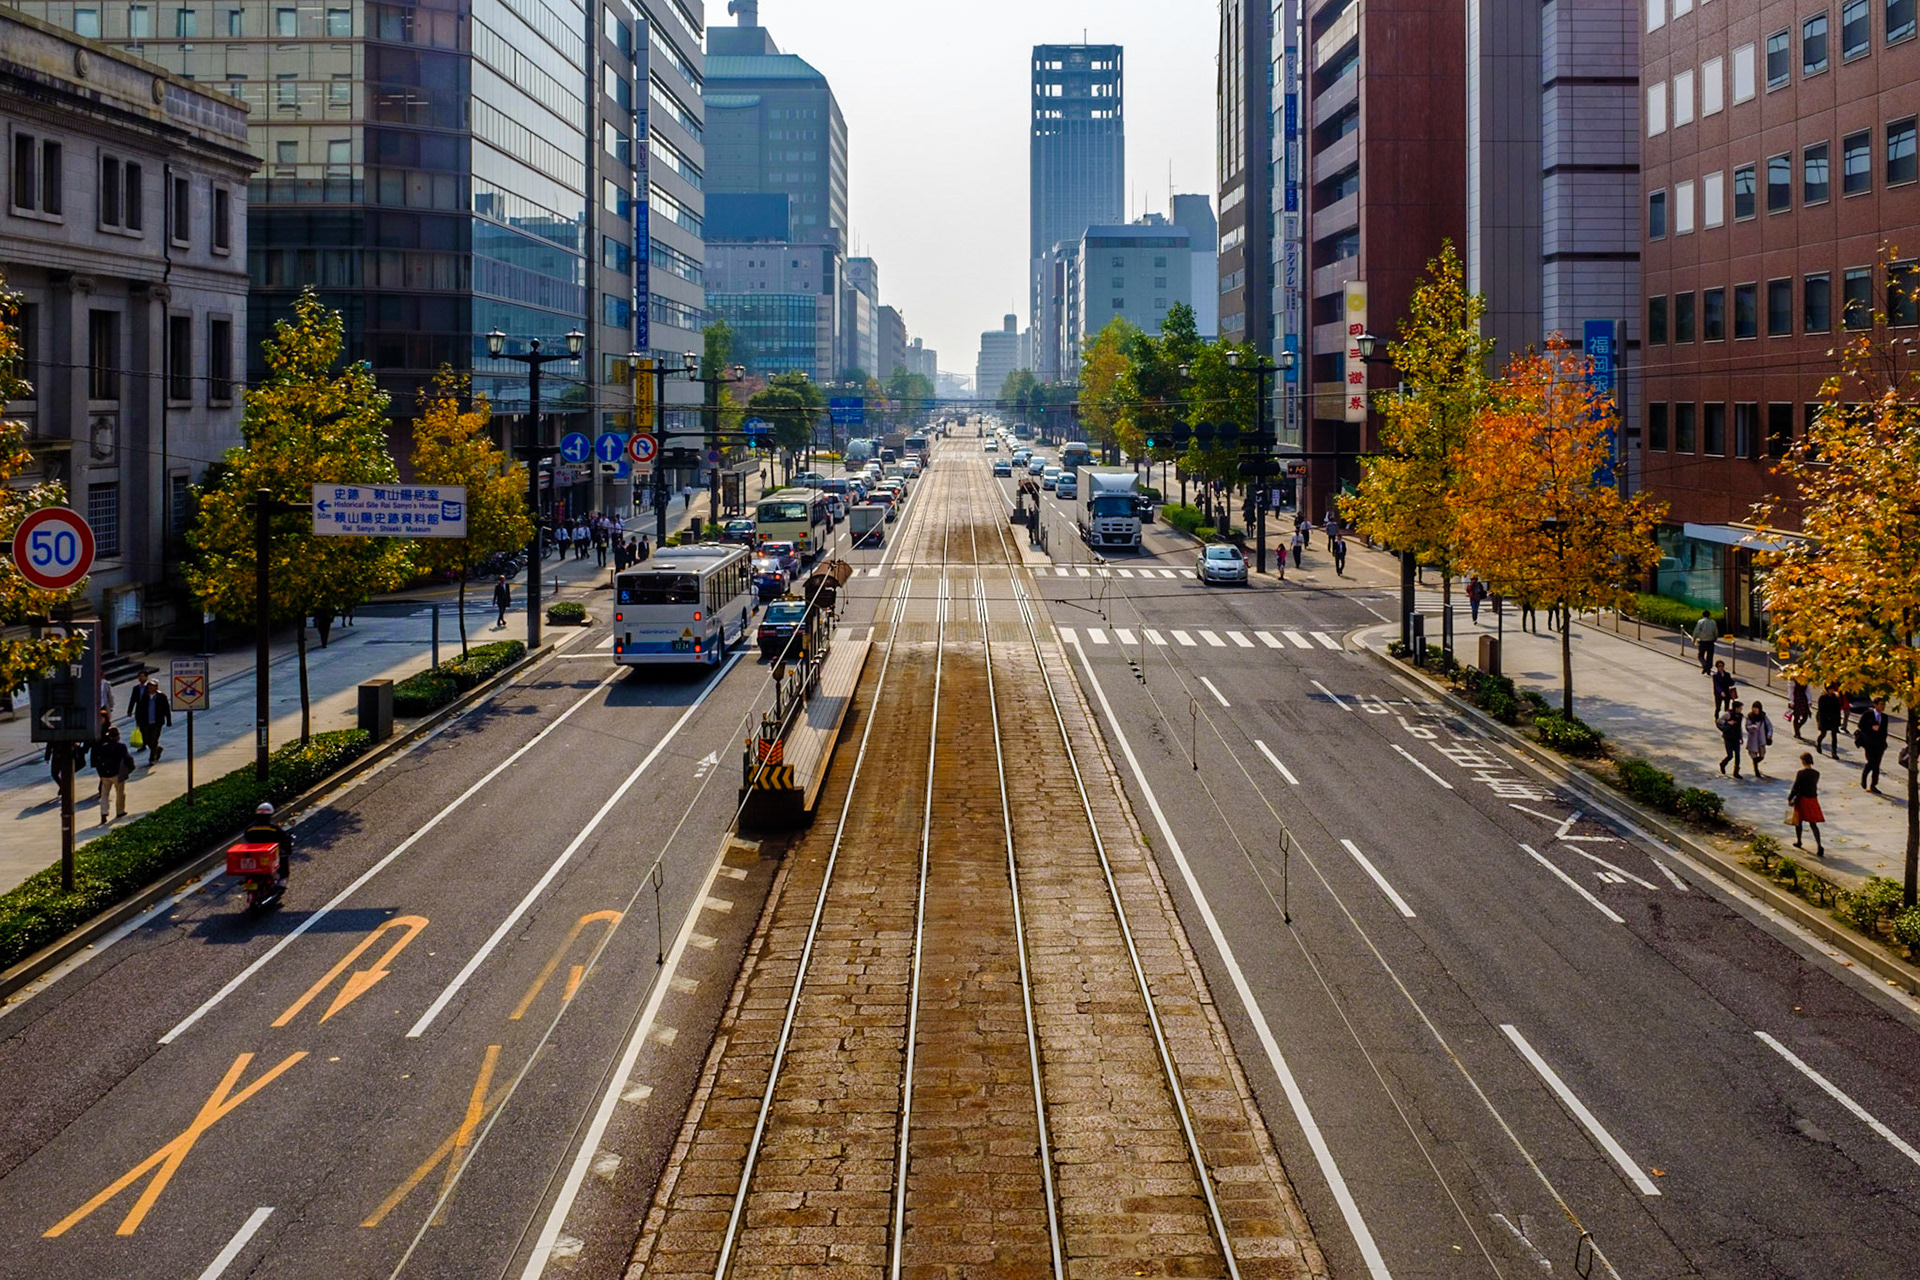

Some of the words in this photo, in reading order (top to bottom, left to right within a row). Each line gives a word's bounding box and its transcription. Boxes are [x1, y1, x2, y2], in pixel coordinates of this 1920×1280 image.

[1589, 335, 1609, 393] 福岡銀
[393, 502, 417, 510] Sanyo's
[356, 525, 375, 533] Sanyo
[32, 530, 75, 566] 50
